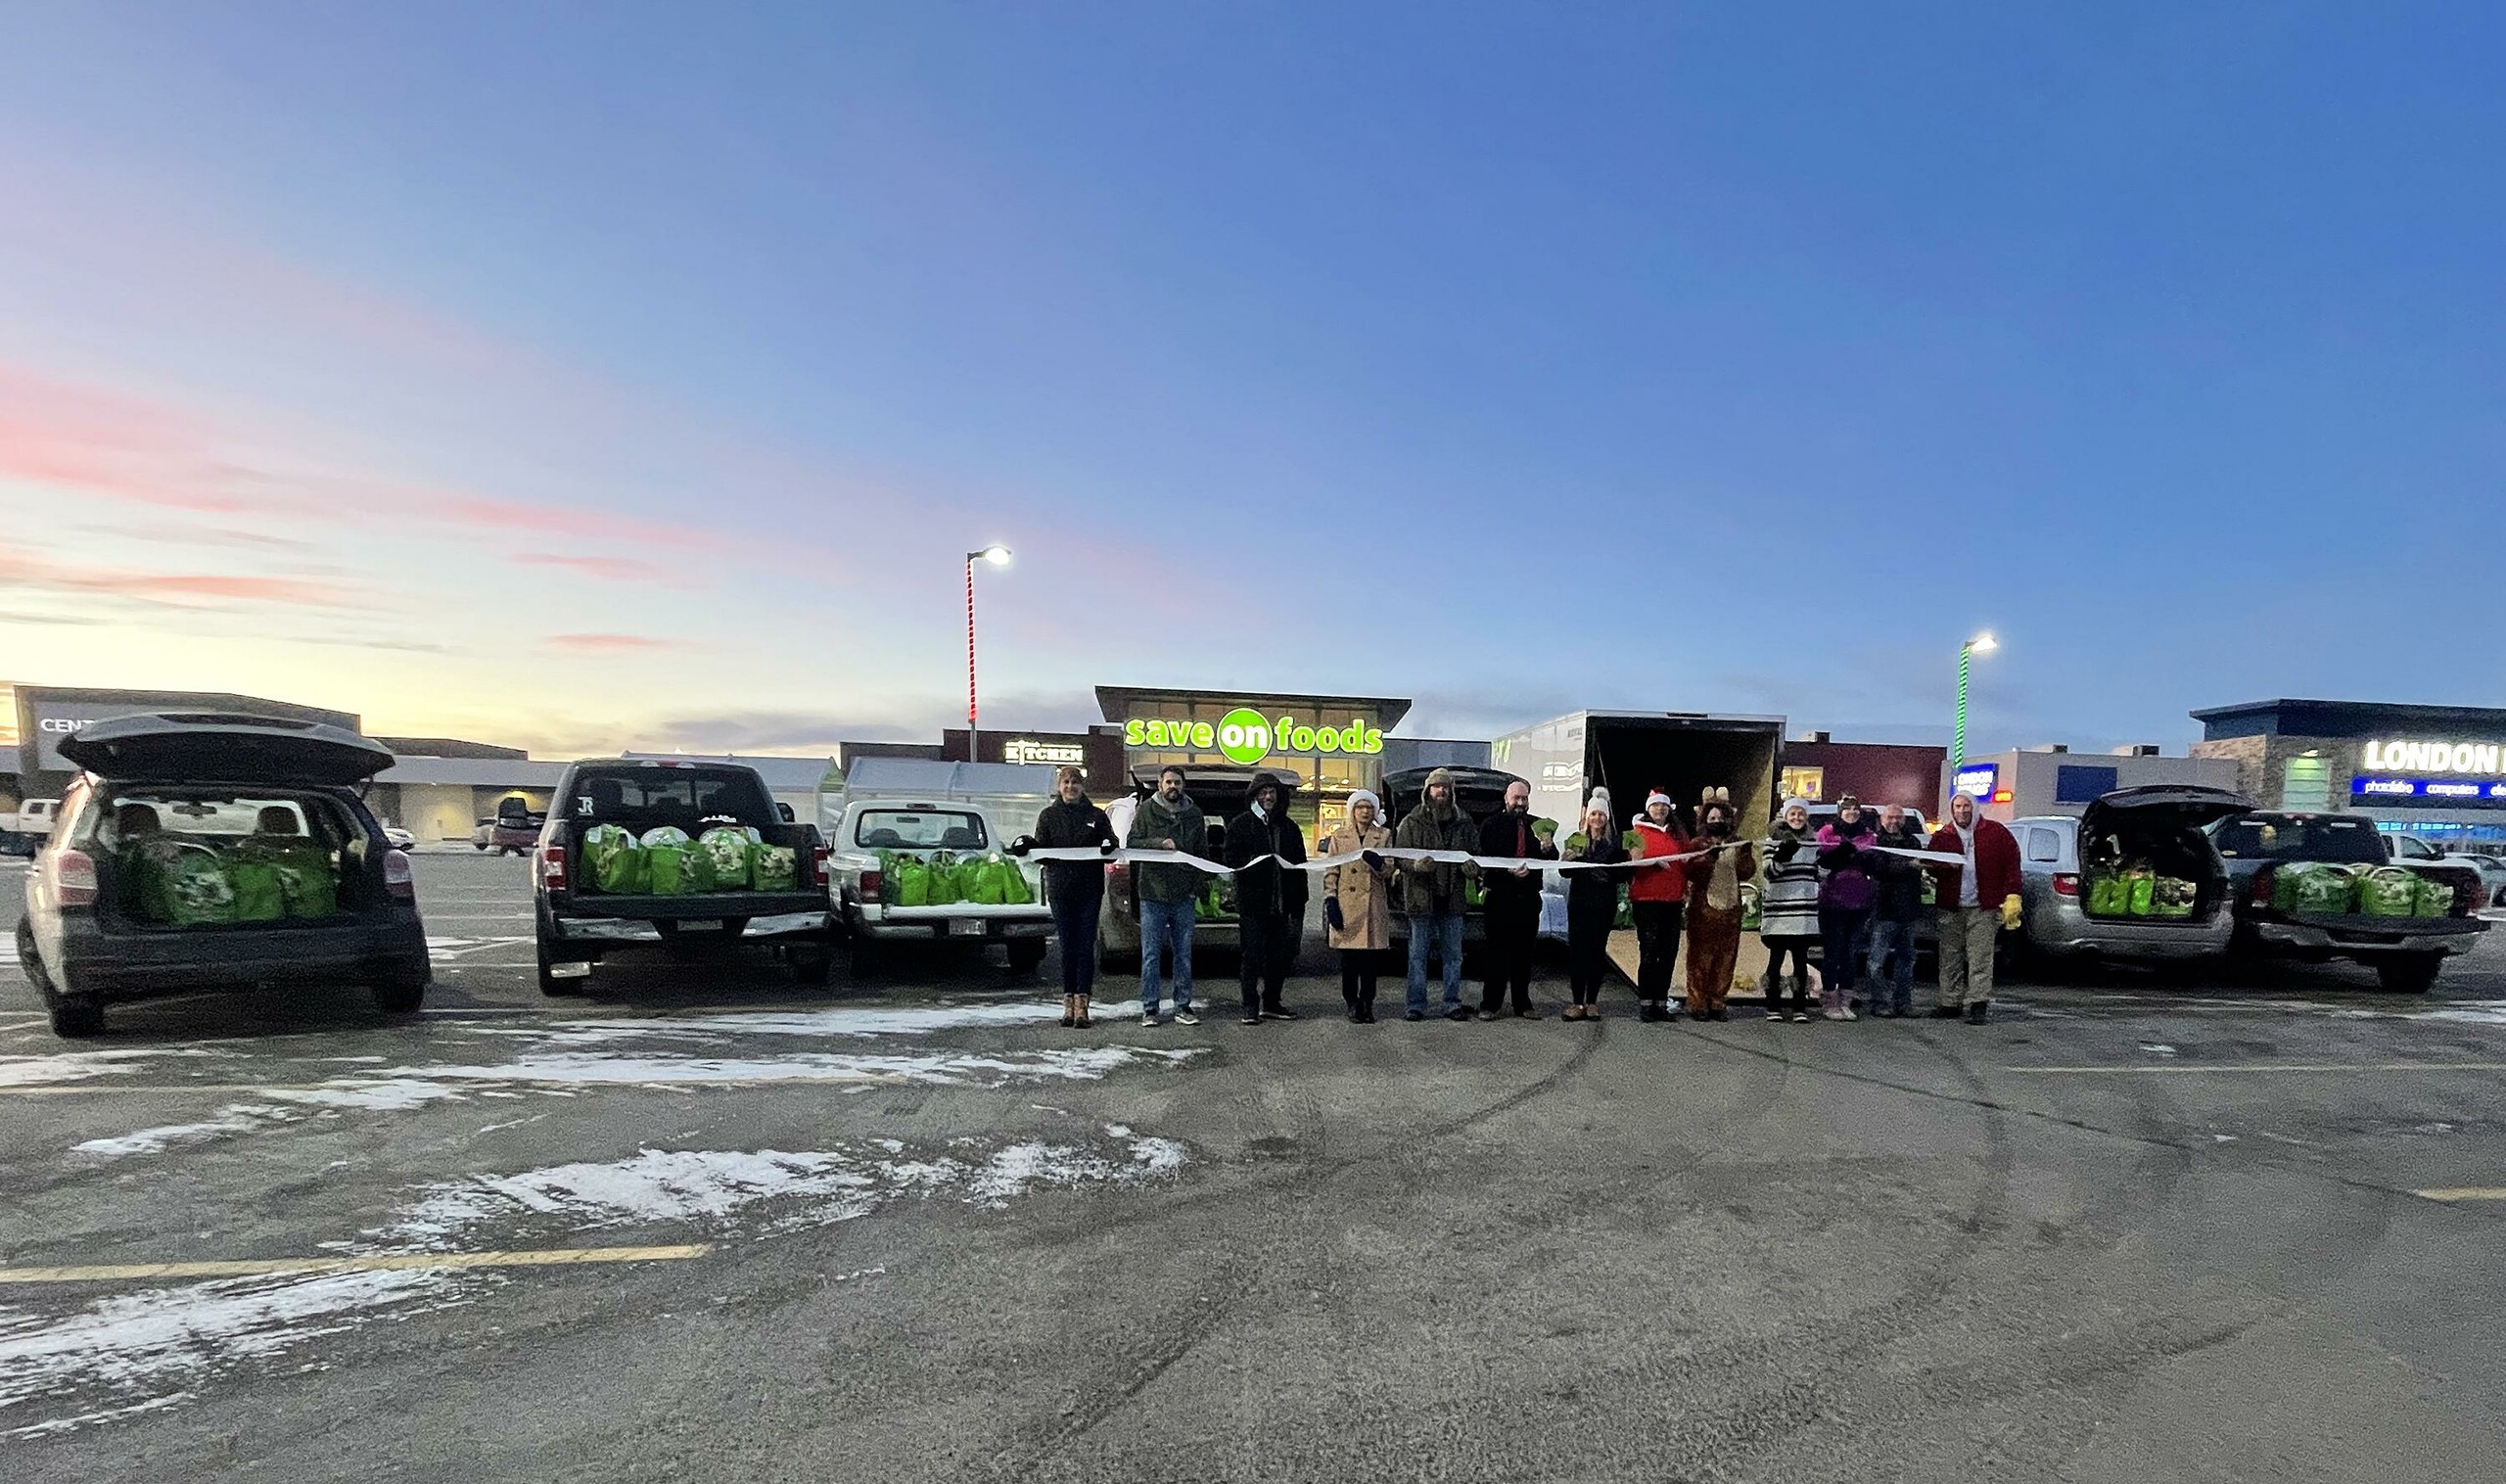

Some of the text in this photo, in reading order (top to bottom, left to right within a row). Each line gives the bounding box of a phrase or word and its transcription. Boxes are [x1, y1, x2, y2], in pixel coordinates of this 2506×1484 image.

[40, 718, 95, 732] CEN
[1125, 717, 1383, 754] save on foods
[1004, 742, 1084, 764] KITCHEN
[2364, 741, 2499, 773] LONDON
